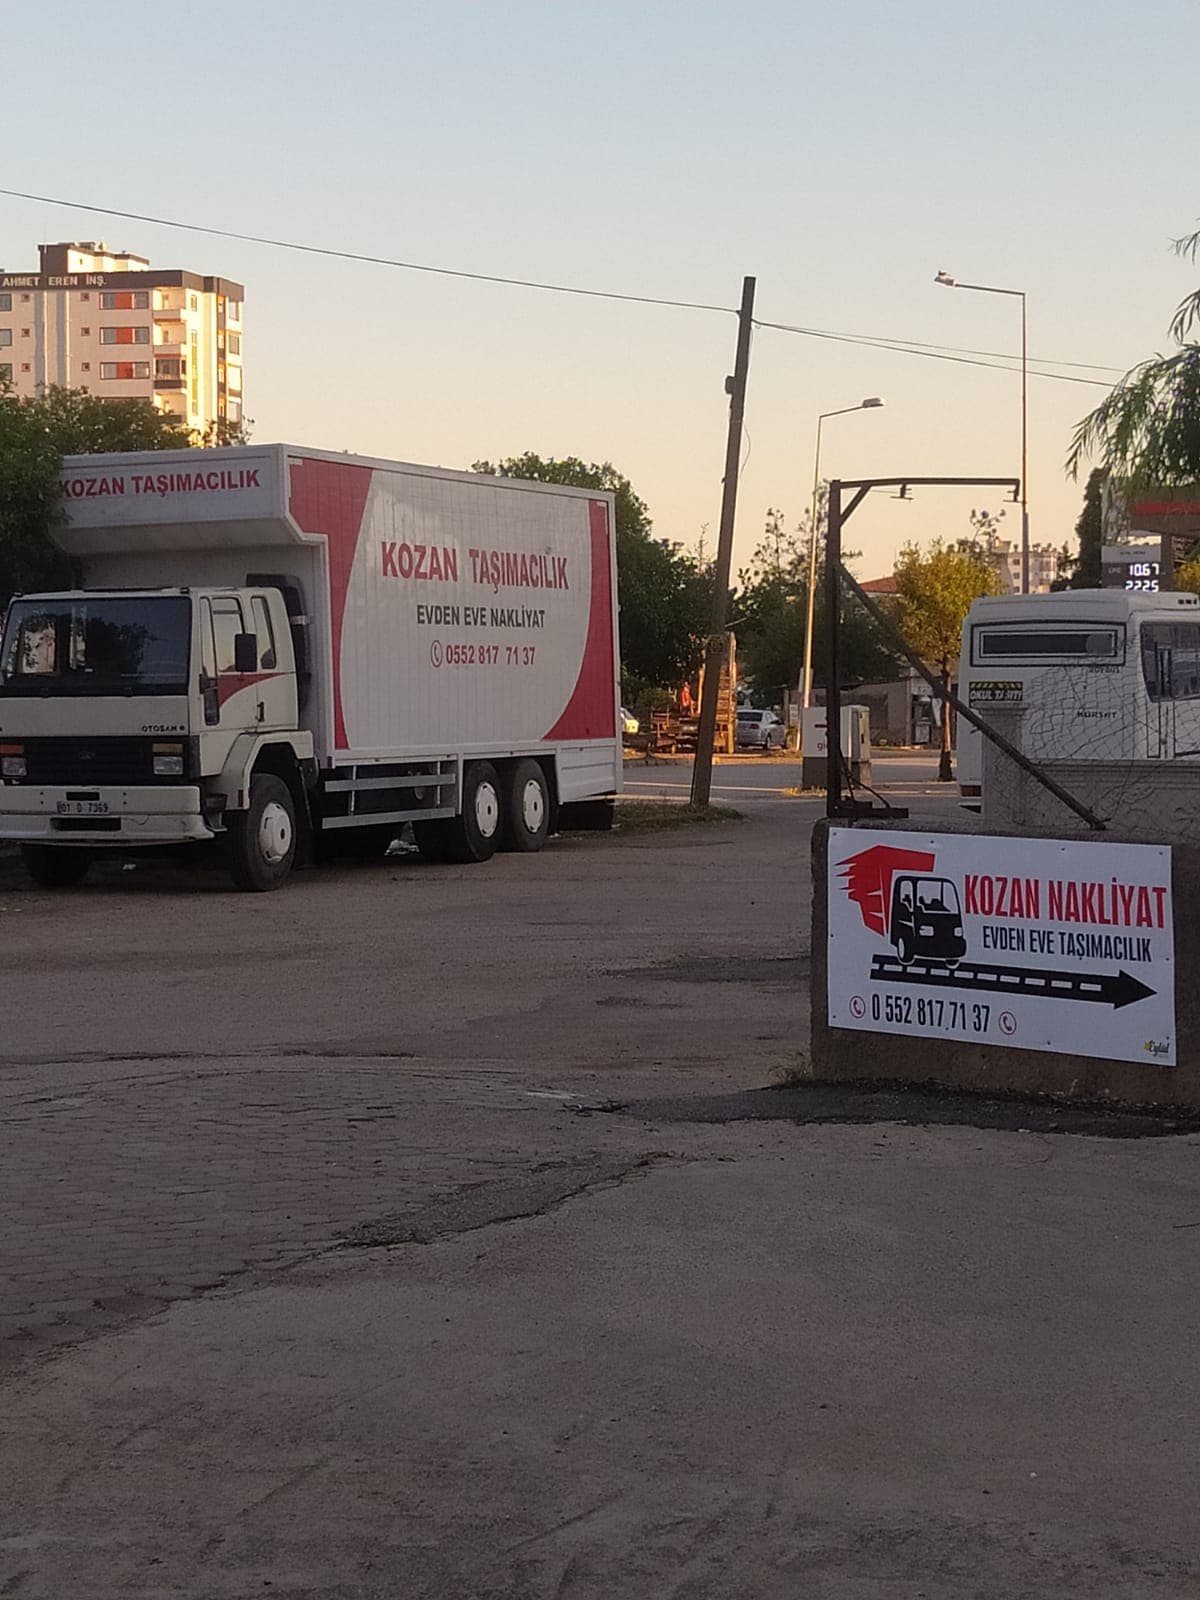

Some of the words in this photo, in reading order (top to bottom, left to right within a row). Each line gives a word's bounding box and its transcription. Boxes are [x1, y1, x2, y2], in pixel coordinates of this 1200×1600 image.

[2, 277, 40, 288] AHMET
[48, 276, 78, 287] EREN
[59, 477, 125, 498] KOZAN
[131, 469, 261, 498] TAŞIMACILIK
[381, 541, 458, 583] KOZAN
[469, 548, 570, 594] TAŞIMACILIK
[417, 604, 460, 626] EVDEN
[464, 606, 487, 627] EVE
[490, 604, 545, 629] NAKLİYAT
[446, 644, 475, 665] 0552
[478, 645, 499, 665] 817
[506, 645, 519, 665] 71
[523, 646, 536, 666] 37
[964, 874, 1041, 920] KOZAN
[1048, 876, 1168, 929] NAKLİYAT
[983, 926, 1026, 953] EVDEN
[1029, 929, 1056, 955] EVE
[1058, 931, 1153, 963] TAŞIMACILIK
[872, 993, 881, 1021] 0
[885, 995, 911, 1024] 552
[950, 1002, 967, 1031] 71
[972, 1005, 991, 1033] 37
